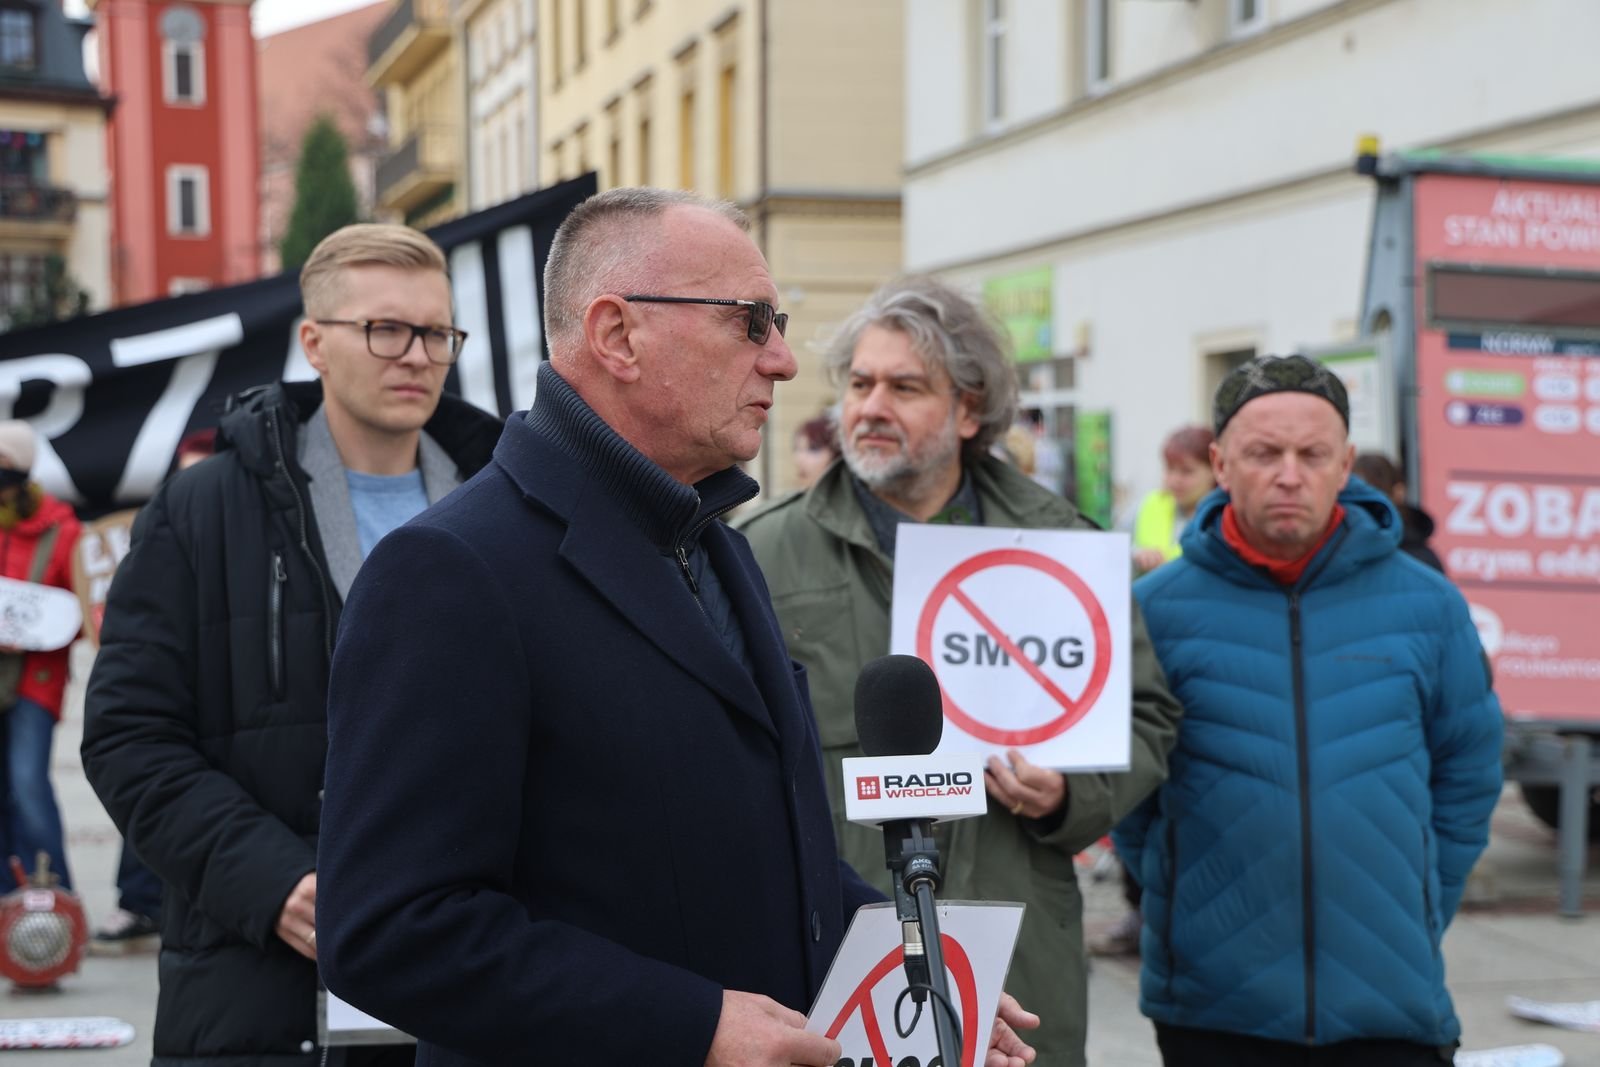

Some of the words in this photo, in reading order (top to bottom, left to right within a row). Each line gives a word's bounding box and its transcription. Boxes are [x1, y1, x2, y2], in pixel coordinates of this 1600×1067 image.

[1444, 215, 1520, 247] STAN
[1480, 332, 1555, 355] NORMY
[1448, 548, 1532, 581] czym
[942, 632, 1084, 668] SMOG
[884, 772, 972, 788] RADIO
[885, 786, 972, 799] WROCŁAW
